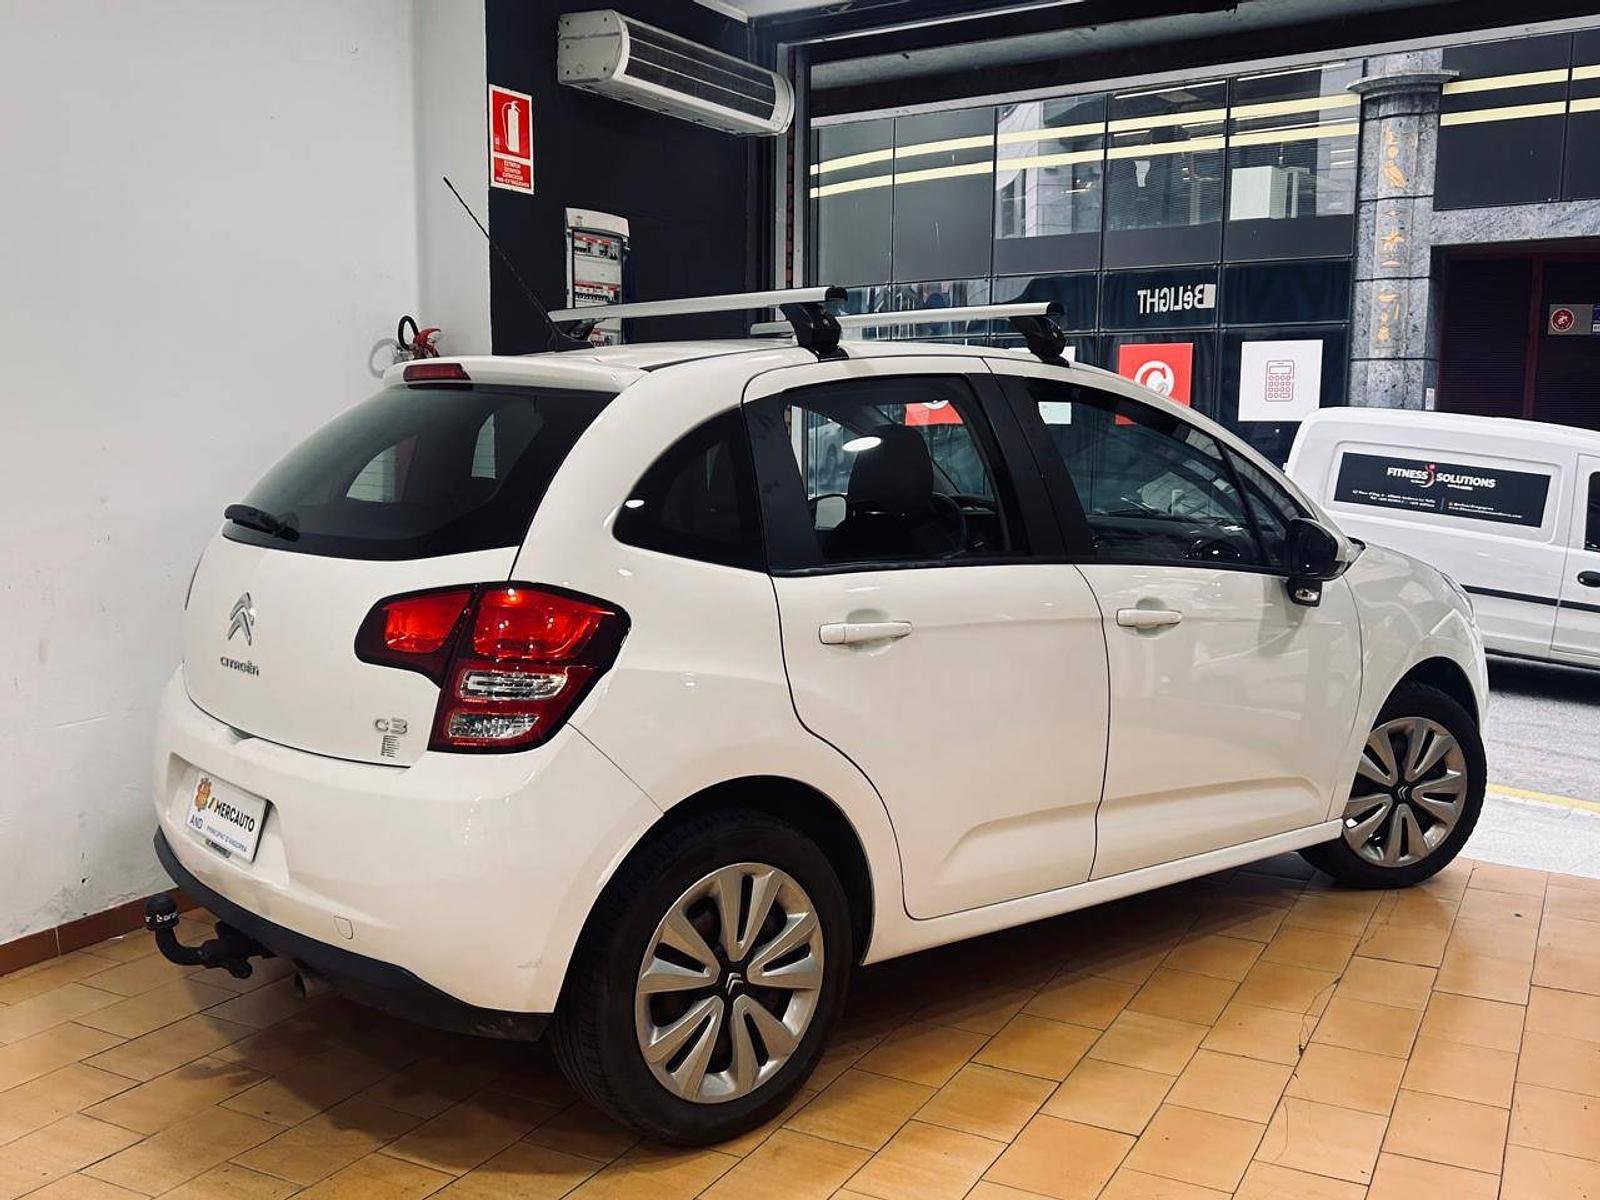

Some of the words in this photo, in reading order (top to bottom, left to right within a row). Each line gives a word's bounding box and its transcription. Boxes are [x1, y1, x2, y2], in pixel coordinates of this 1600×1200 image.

[1387, 467, 1428, 480] FITNESS
[1436, 473, 1496, 488] SOLUTIONS
[375, 718, 407, 735] C3
[189, 814, 204, 829] AND
[213, 800, 255, 832] MERCAUTO
